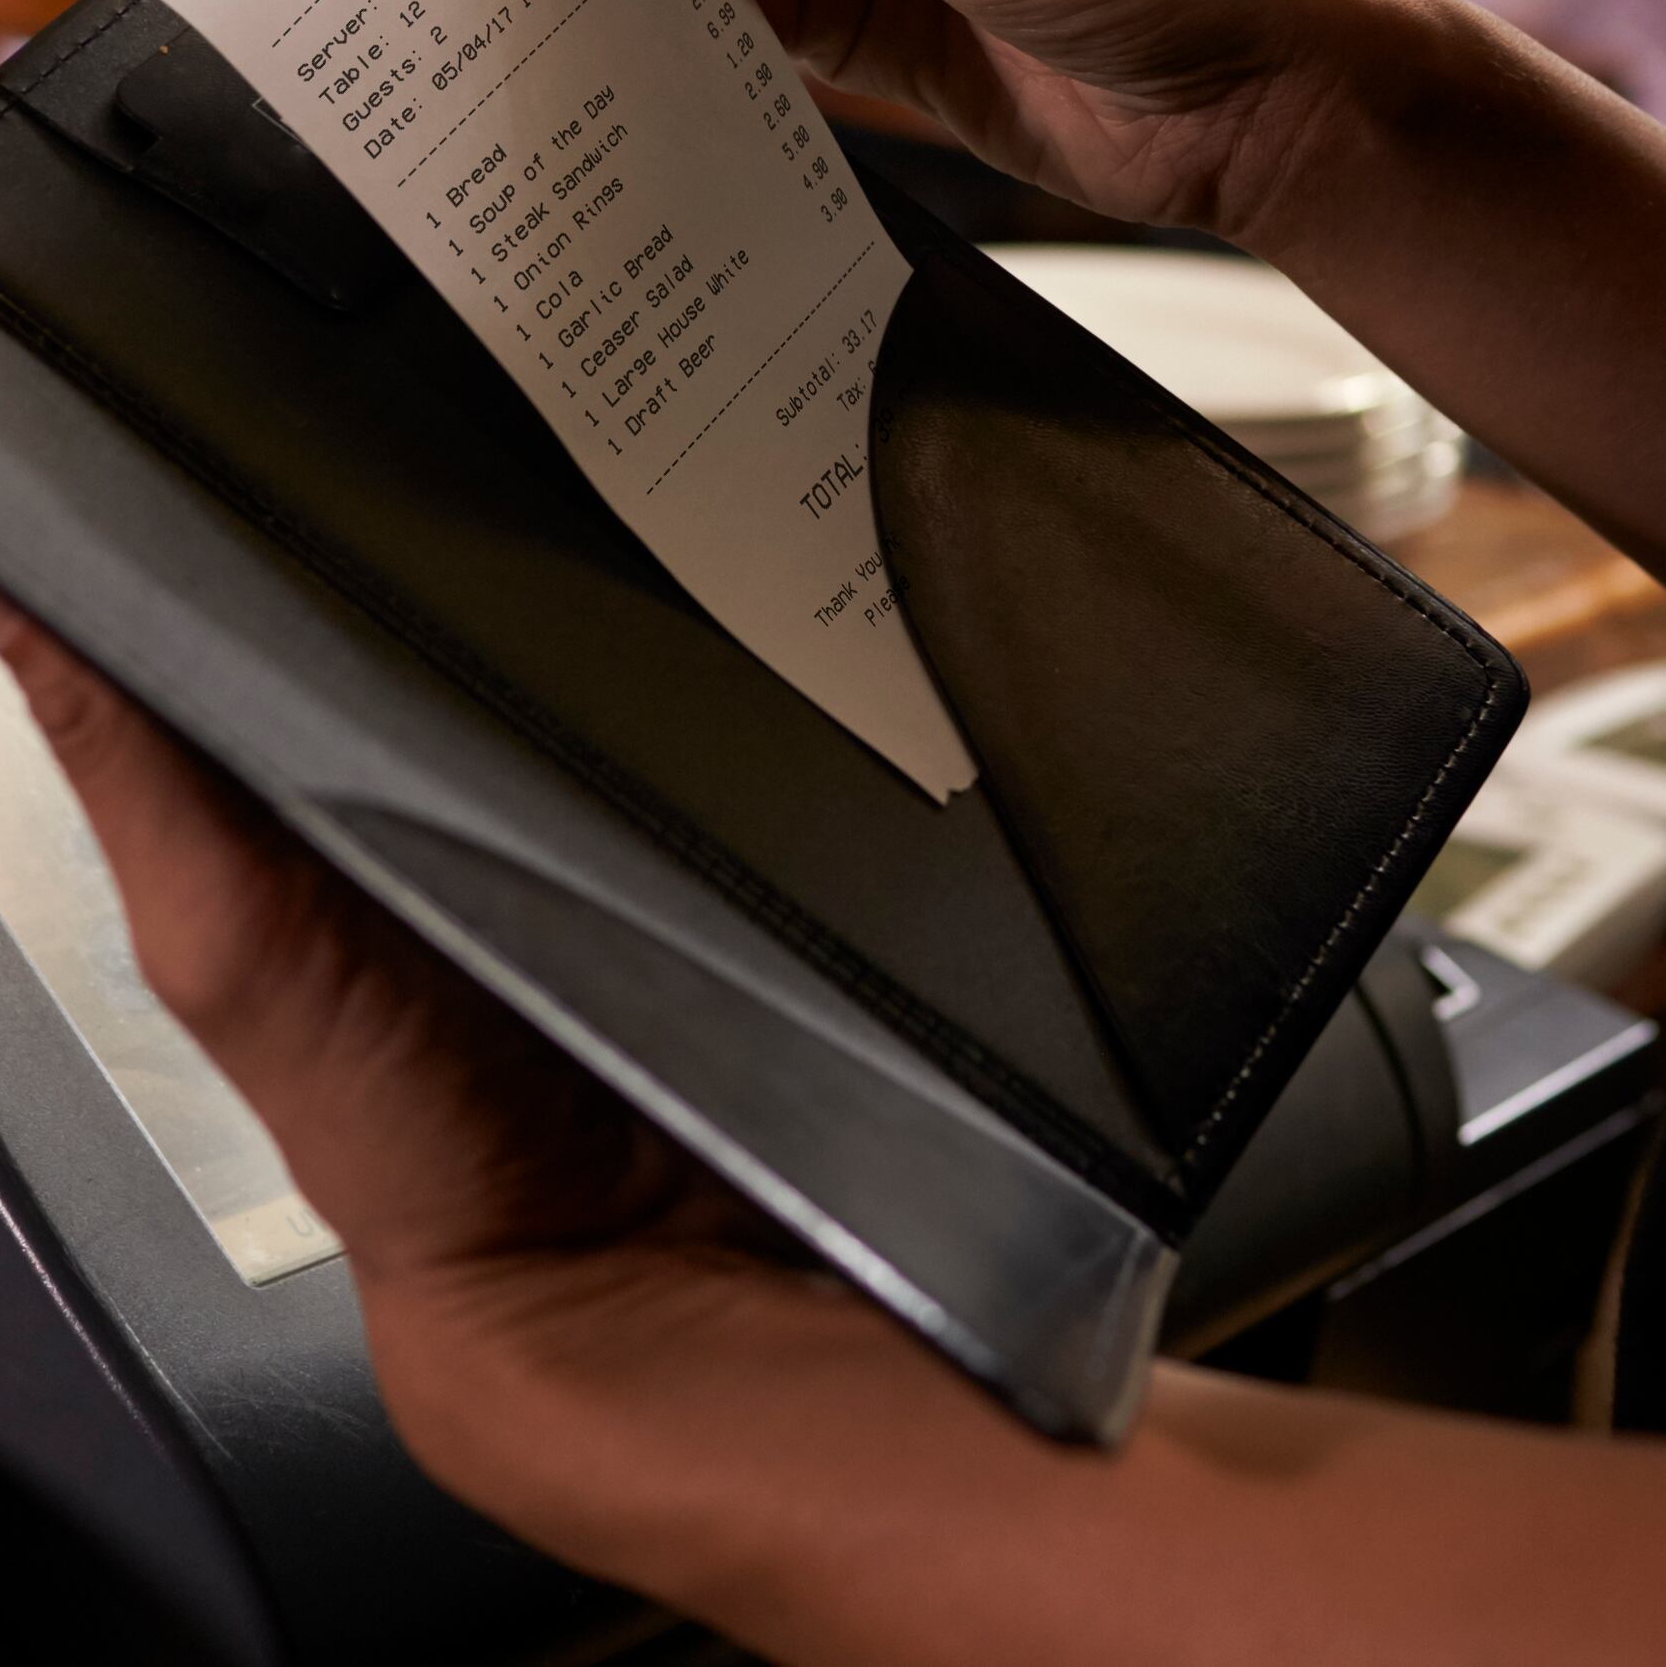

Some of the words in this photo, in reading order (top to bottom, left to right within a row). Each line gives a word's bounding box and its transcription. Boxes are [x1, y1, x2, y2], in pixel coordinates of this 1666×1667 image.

[297, 0, 378, 82] Server:
[318, 35, 389, 105] Table:
[399, 1, 426, 28] 12
[342, 50, 422, 132] Guests:
[430, 26, 448, 45] 2
[364, 97, 422, 159] Date:
[432, 6, 513, 91] 05/04/17
[426, 212, 441, 229] 1
[446, 143, 507, 208] Bread
[448, 239, 463, 256] 1
[469, 184, 515, 234] Soup
[523, 152, 545, 181] of
[552, 120, 582, 150] the
[583, 85, 615, 120] Day
[471, 267, 486, 285] 1
[491, 202, 550, 262] Steak
[552, 123, 628, 201] Sandwich
[707, 2, 736, 39] 6.99
[493, 295, 509, 313] 1
[513, 232, 572, 290] Onion
[572, 178, 624, 231] Rings
[726, 32, 754, 69] 1.20
[516, 324, 531, 341] 1
[535, 270, 584, 320] Cola
[744, 63, 773, 101] 2.90
[538, 352, 554, 370] 1
[558, 280, 623, 348] Garlic
[623, 224, 674, 280] Bread
[763, 94, 791, 131] 2.60
[561, 381, 576, 399] 1
[580, 310, 639, 377] Ceaser
[645, 254, 694, 308] Salad
[782, 125, 810, 161] 5.80
[584, 409, 600, 427] 1
[602, 349, 657, 408] Large
[657, 296, 706, 348] House
[705, 249, 749, 296] White
[802, 156, 829, 191] 4.90
[607, 438, 623, 456] 1
[624, 377, 677, 436] Draft
[678, 334, 715, 378] Beer
[821, 187, 848, 223] 3.90
[776, 352, 840, 426] Subtotal:
[842, 309, 877, 354] 33.17
[836, 377, 867, 412] Tax:
[799, 443, 868, 520] TOTAL:
[814, 581, 858, 627] Thank
[855, 552, 883, 581] You
